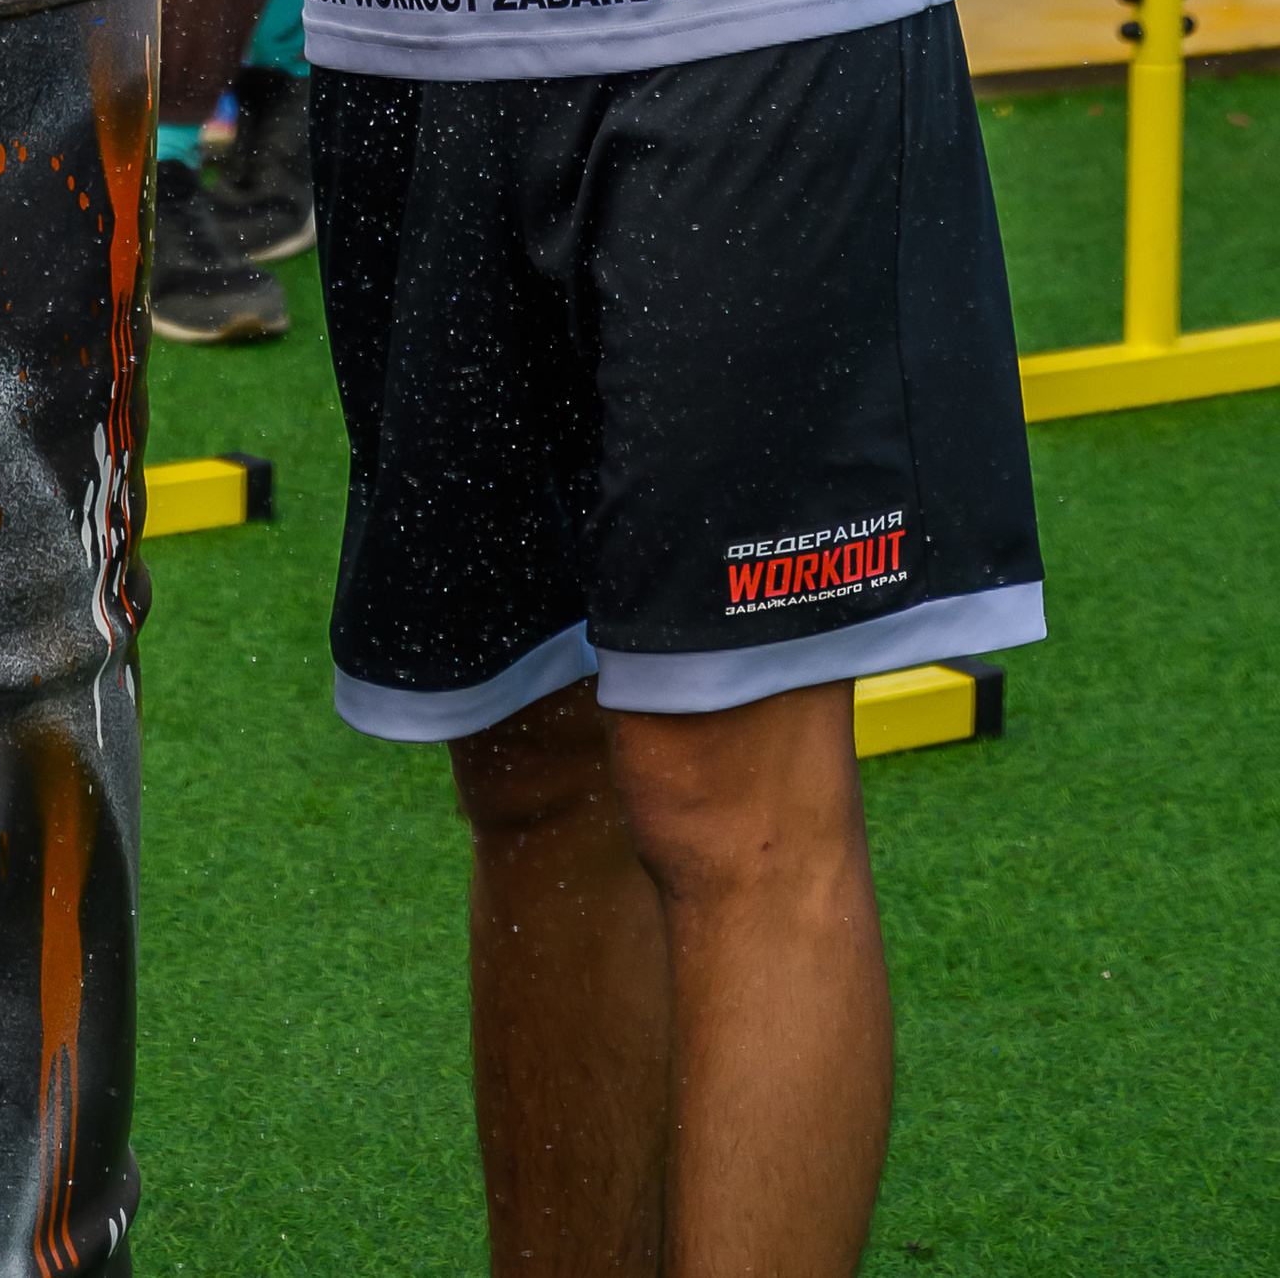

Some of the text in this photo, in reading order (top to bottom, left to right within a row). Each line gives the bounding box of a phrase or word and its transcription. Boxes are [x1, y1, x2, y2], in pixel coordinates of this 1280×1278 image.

[727, 510, 903, 559] ФЕДЕРАЦИЯ
[728, 530, 906, 604] WORKOUT
[725, 571, 908, 616] ЗАБАЙКАЛЬСКОГО КРАЯ
